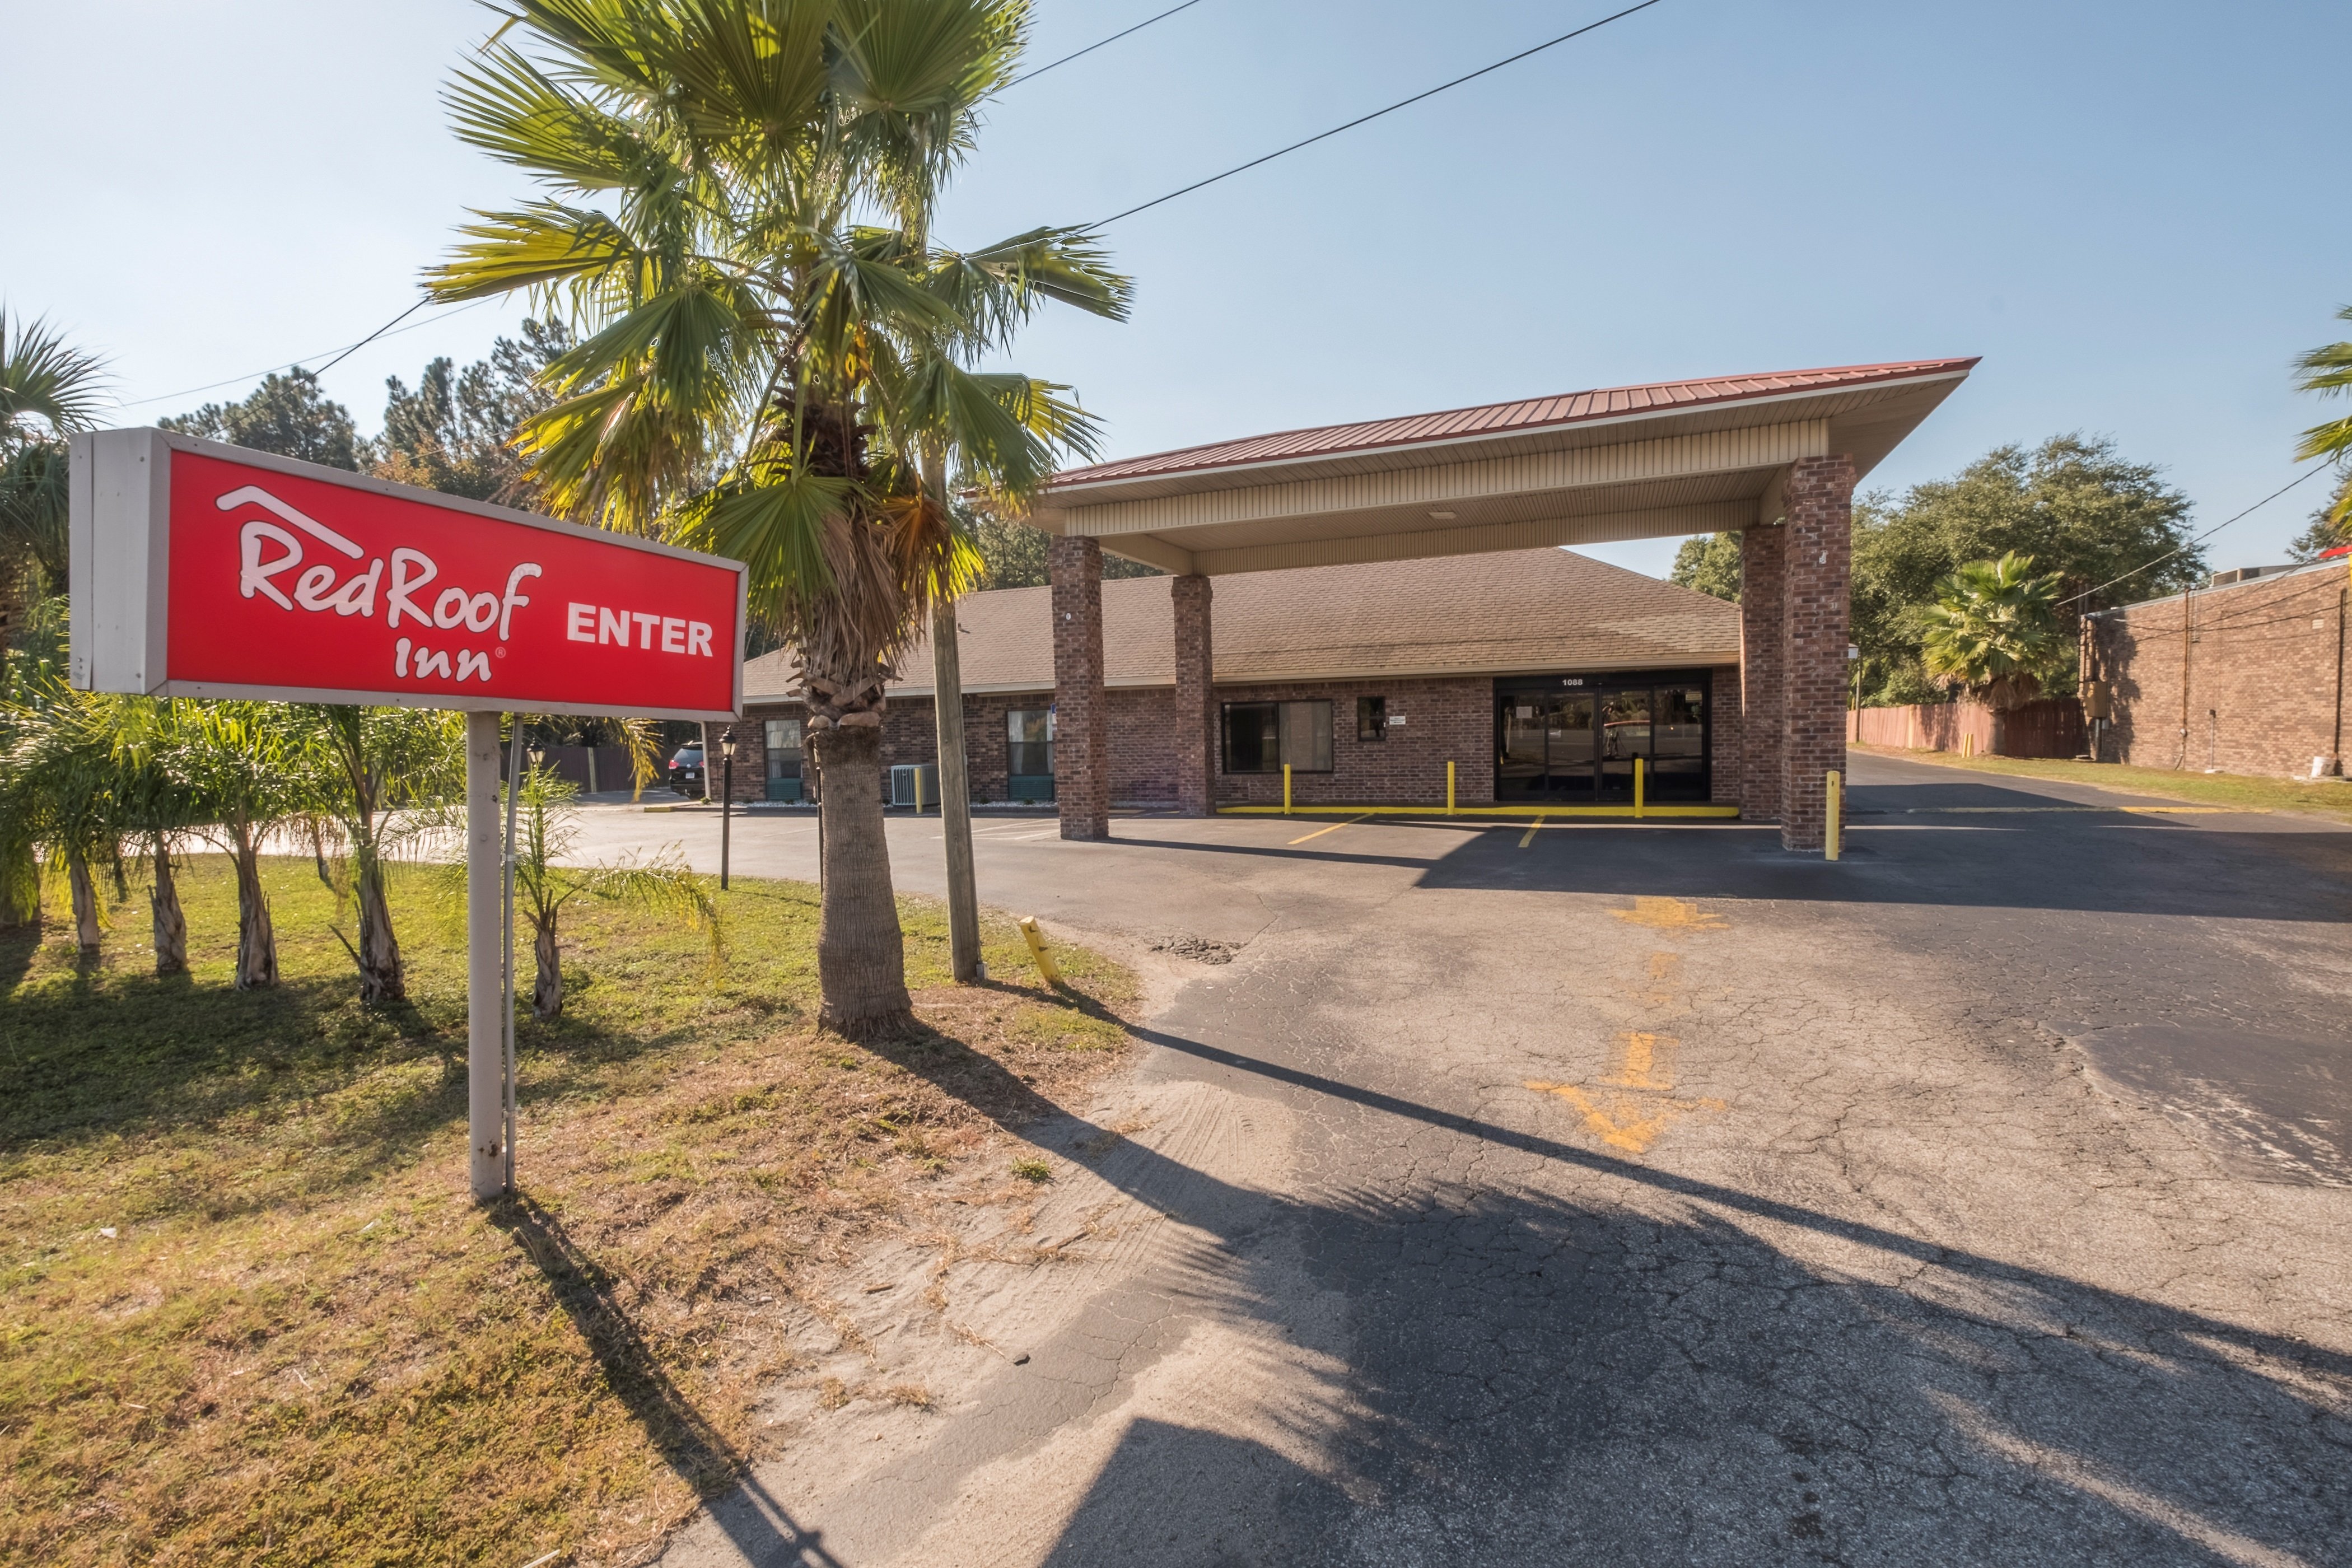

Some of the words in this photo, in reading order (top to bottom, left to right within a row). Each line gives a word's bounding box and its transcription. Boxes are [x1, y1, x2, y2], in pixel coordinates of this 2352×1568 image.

[240, 520, 384, 617] Red
[386, 547, 543, 641] Roof
[567, 602, 713, 657] ENTER
[395, 637, 492, 682] Inn
